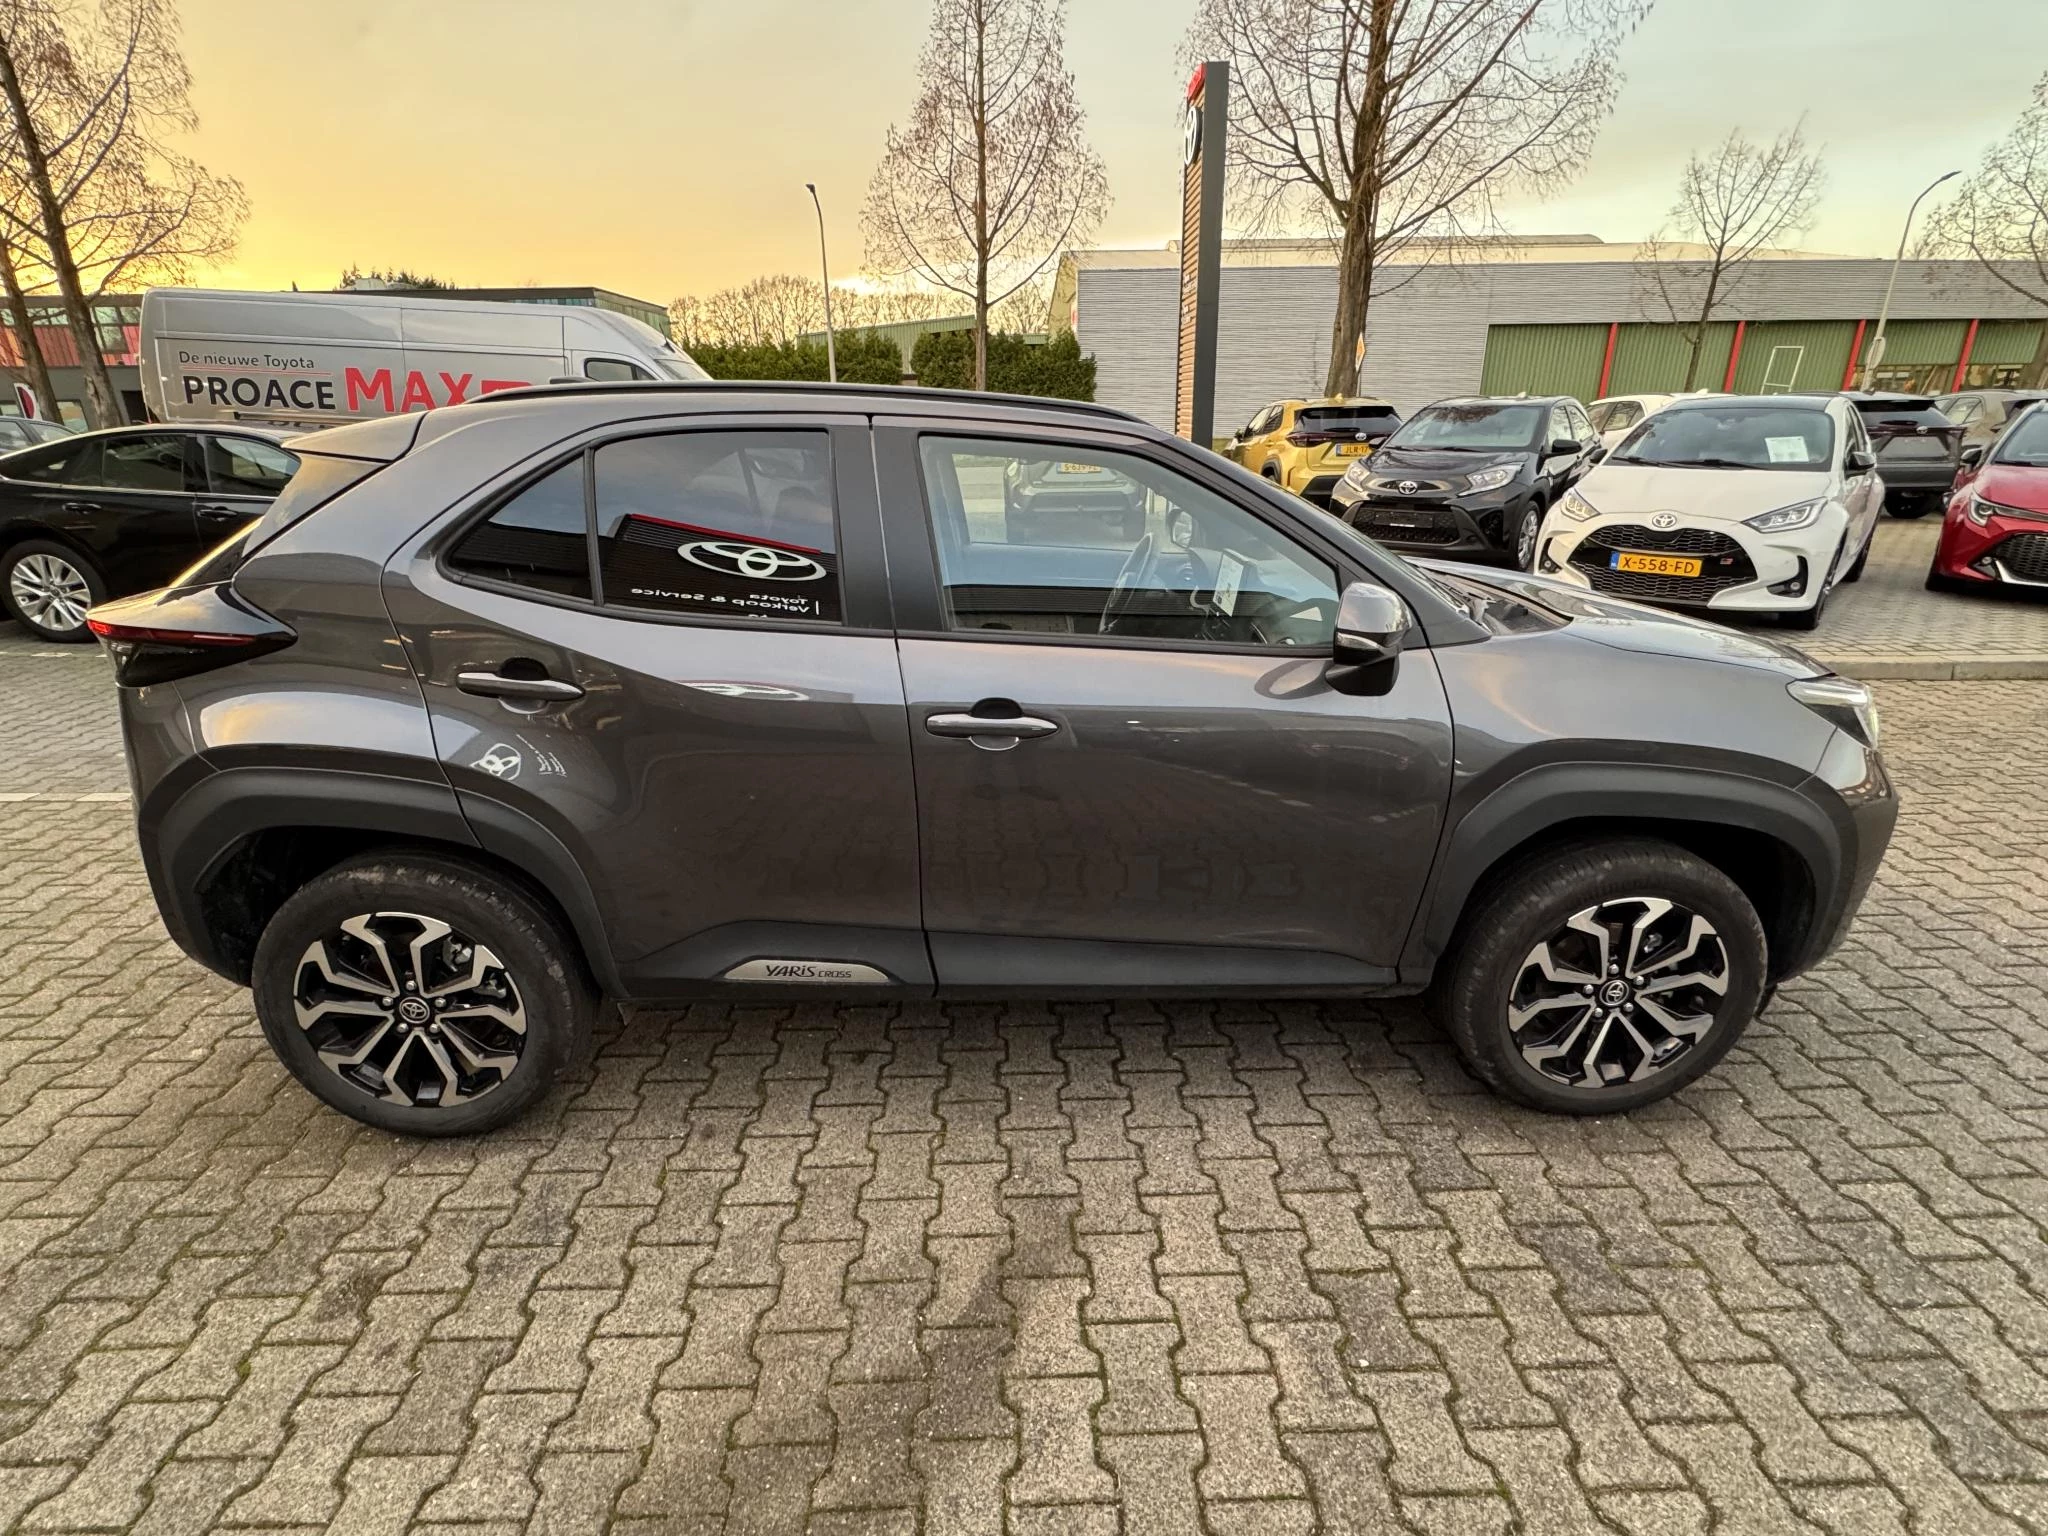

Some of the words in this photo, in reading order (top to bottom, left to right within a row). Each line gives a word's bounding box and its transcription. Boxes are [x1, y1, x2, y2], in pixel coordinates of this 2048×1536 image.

[179, 351, 201, 364] De
[204, 352, 260, 368] nieuwe
[264, 354, 315, 371] Toyota
[183, 375, 336, 410] PROACE
[345, 367, 473, 413] MAX
[1623, 557, 1695, 574] X-558-FD
[818, 970, 852, 978] CROSS
